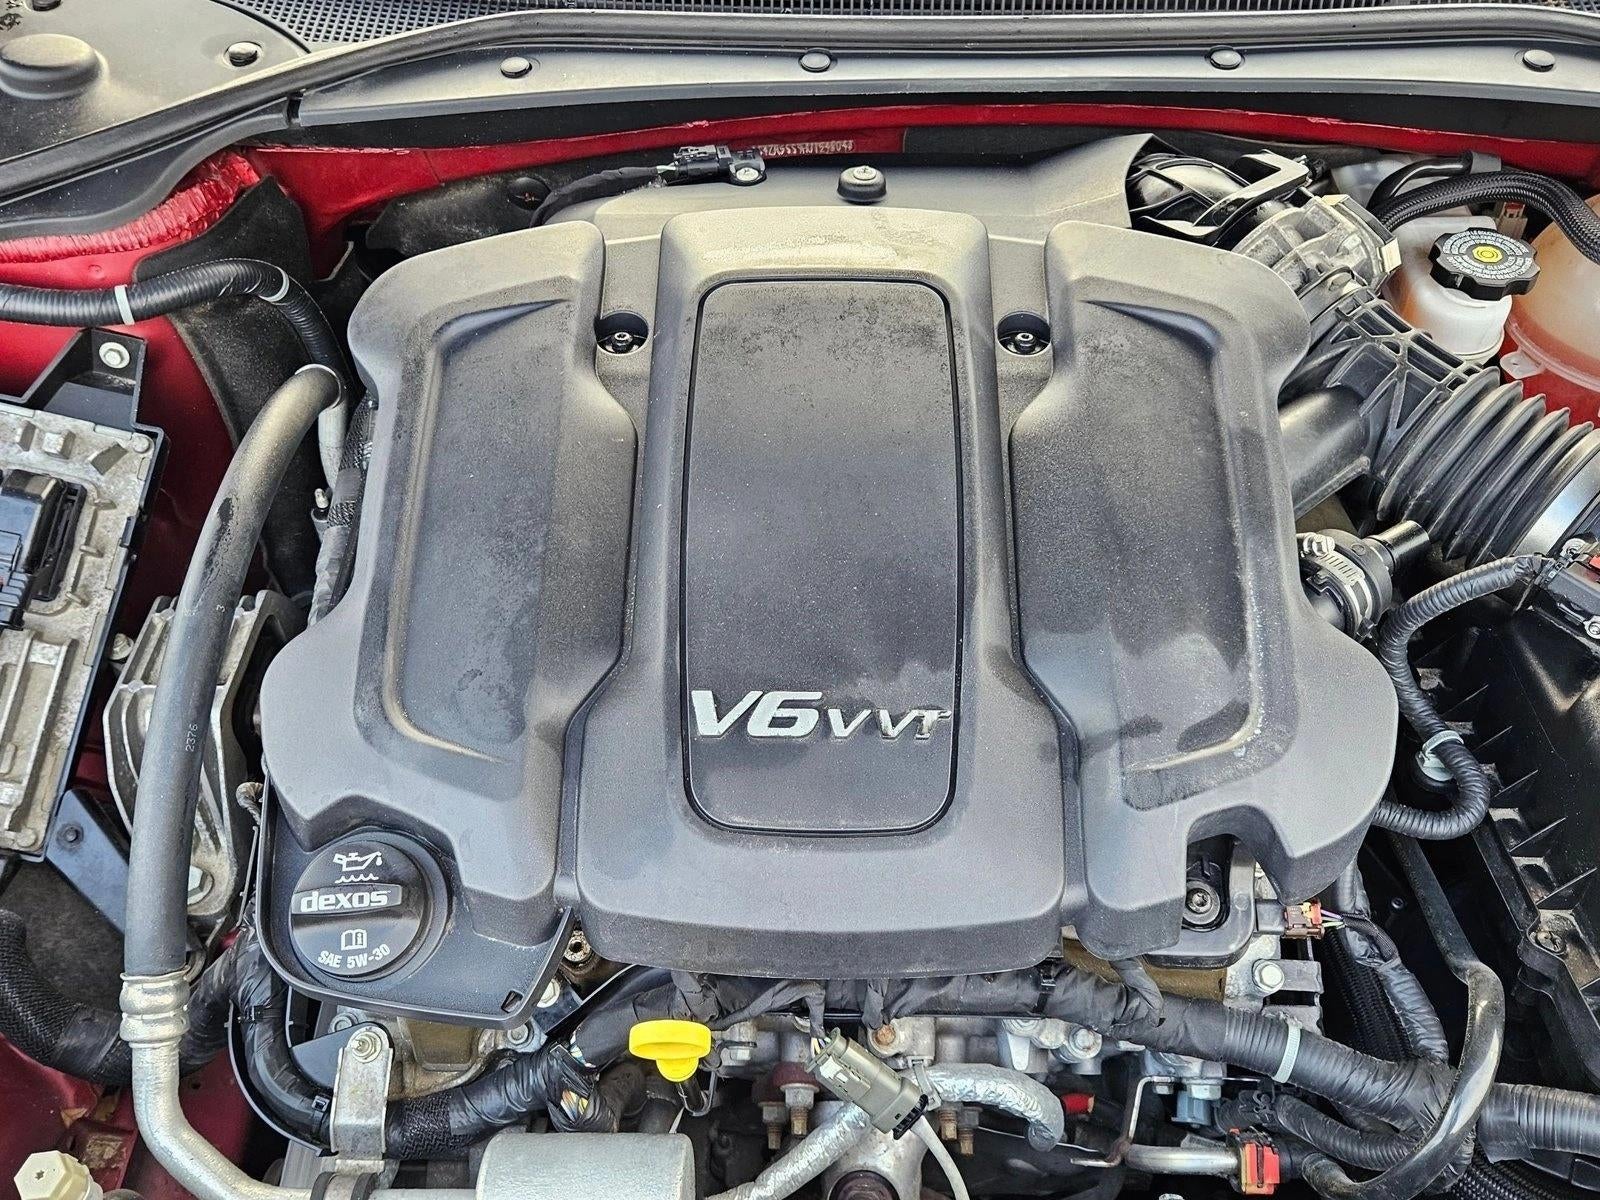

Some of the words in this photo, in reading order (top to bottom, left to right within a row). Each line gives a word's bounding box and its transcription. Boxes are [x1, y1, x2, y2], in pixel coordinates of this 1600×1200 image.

[691, 690, 823, 739] V6
[827, 709, 952, 741] VVT
[185, 723, 198, 752] 2376
[300, 890, 388, 913] dexos
[317, 950, 342, 968] SAE
[346, 943, 391, 969] 5W-30
